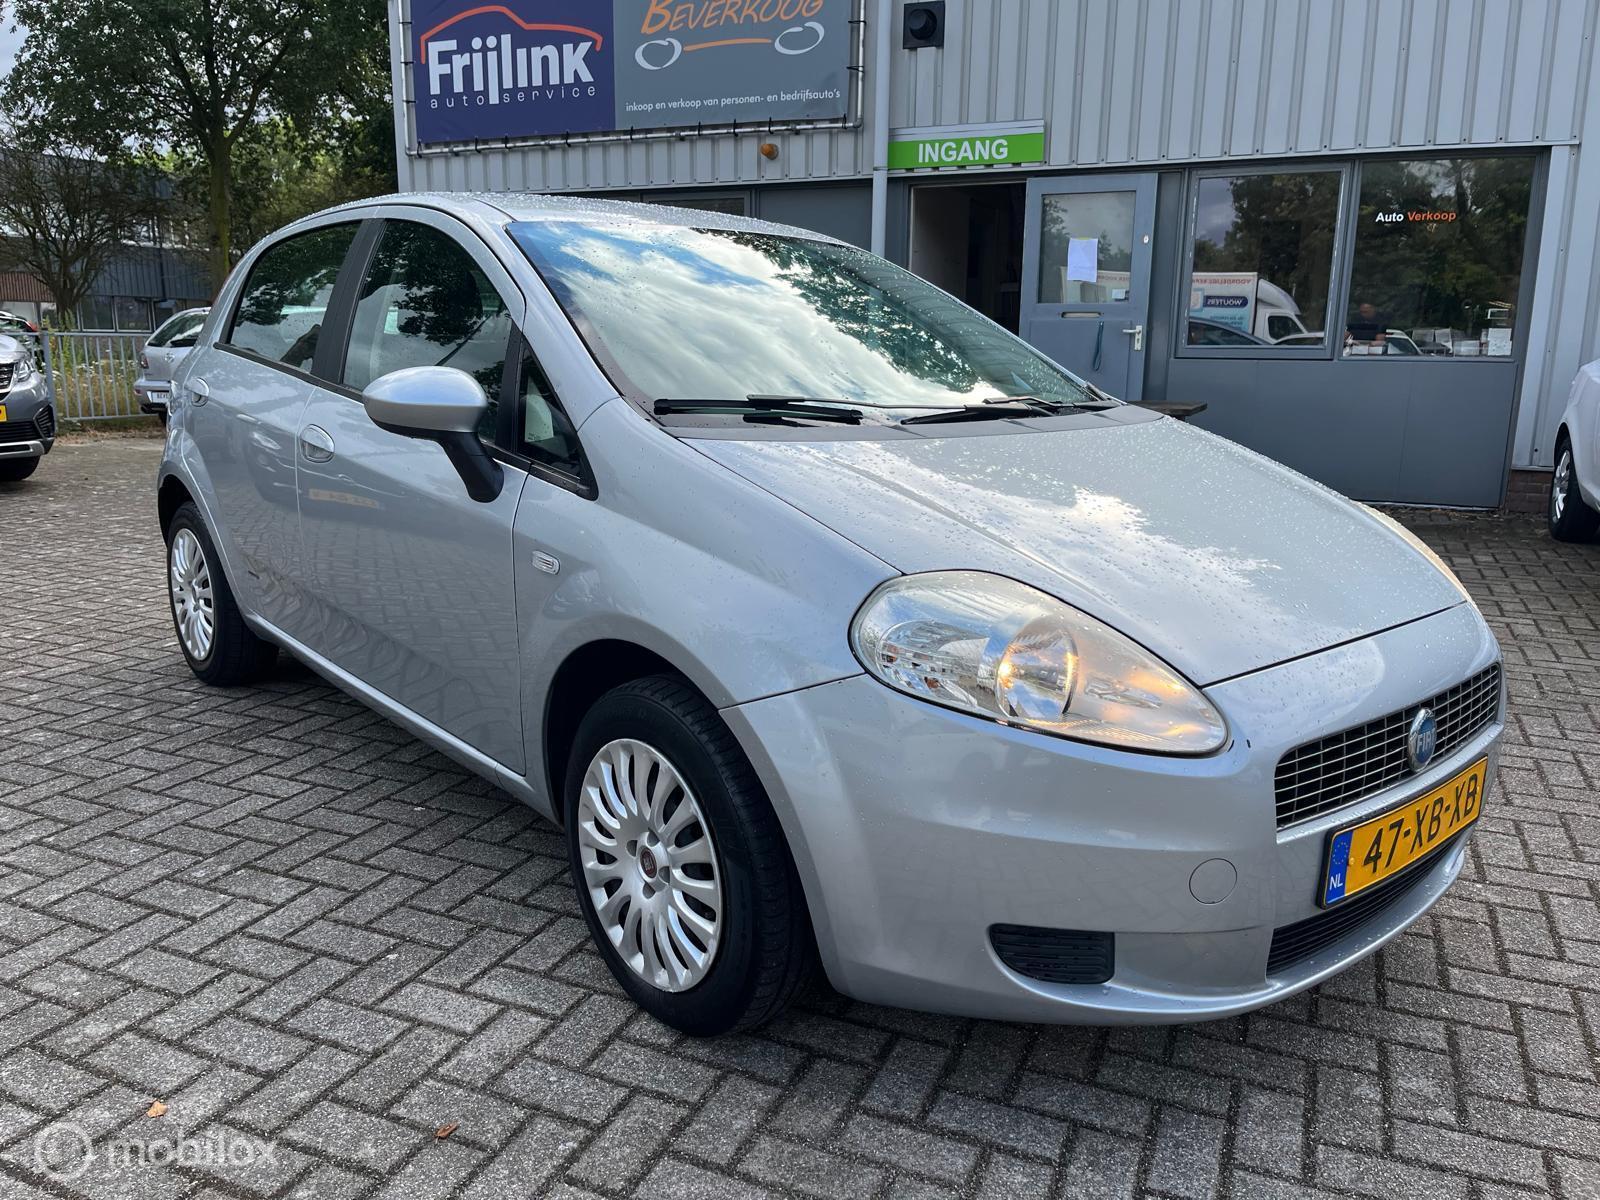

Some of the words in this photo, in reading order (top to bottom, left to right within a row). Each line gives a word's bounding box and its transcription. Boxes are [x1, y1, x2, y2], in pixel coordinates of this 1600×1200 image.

[641, 0, 824, 35] BEVERKOOG
[427, 33, 595, 105] Frijlink
[626, 100, 654, 112] inkoop
[655, 101, 666, 110] en
[668, 97, 701, 110] verkoop
[703, 97, 719, 106] van
[721, 95, 764, 107] personen-
[767, 93, 778, 102] en
[918, 139, 1008, 163] INGANG
[1375, 211, 1404, 223] Auto
[1407, 210, 1457, 222] Verkoop
[1362, 773, 1479, 874] 47-XB-XB
[1329, 874, 1344, 891] NL
